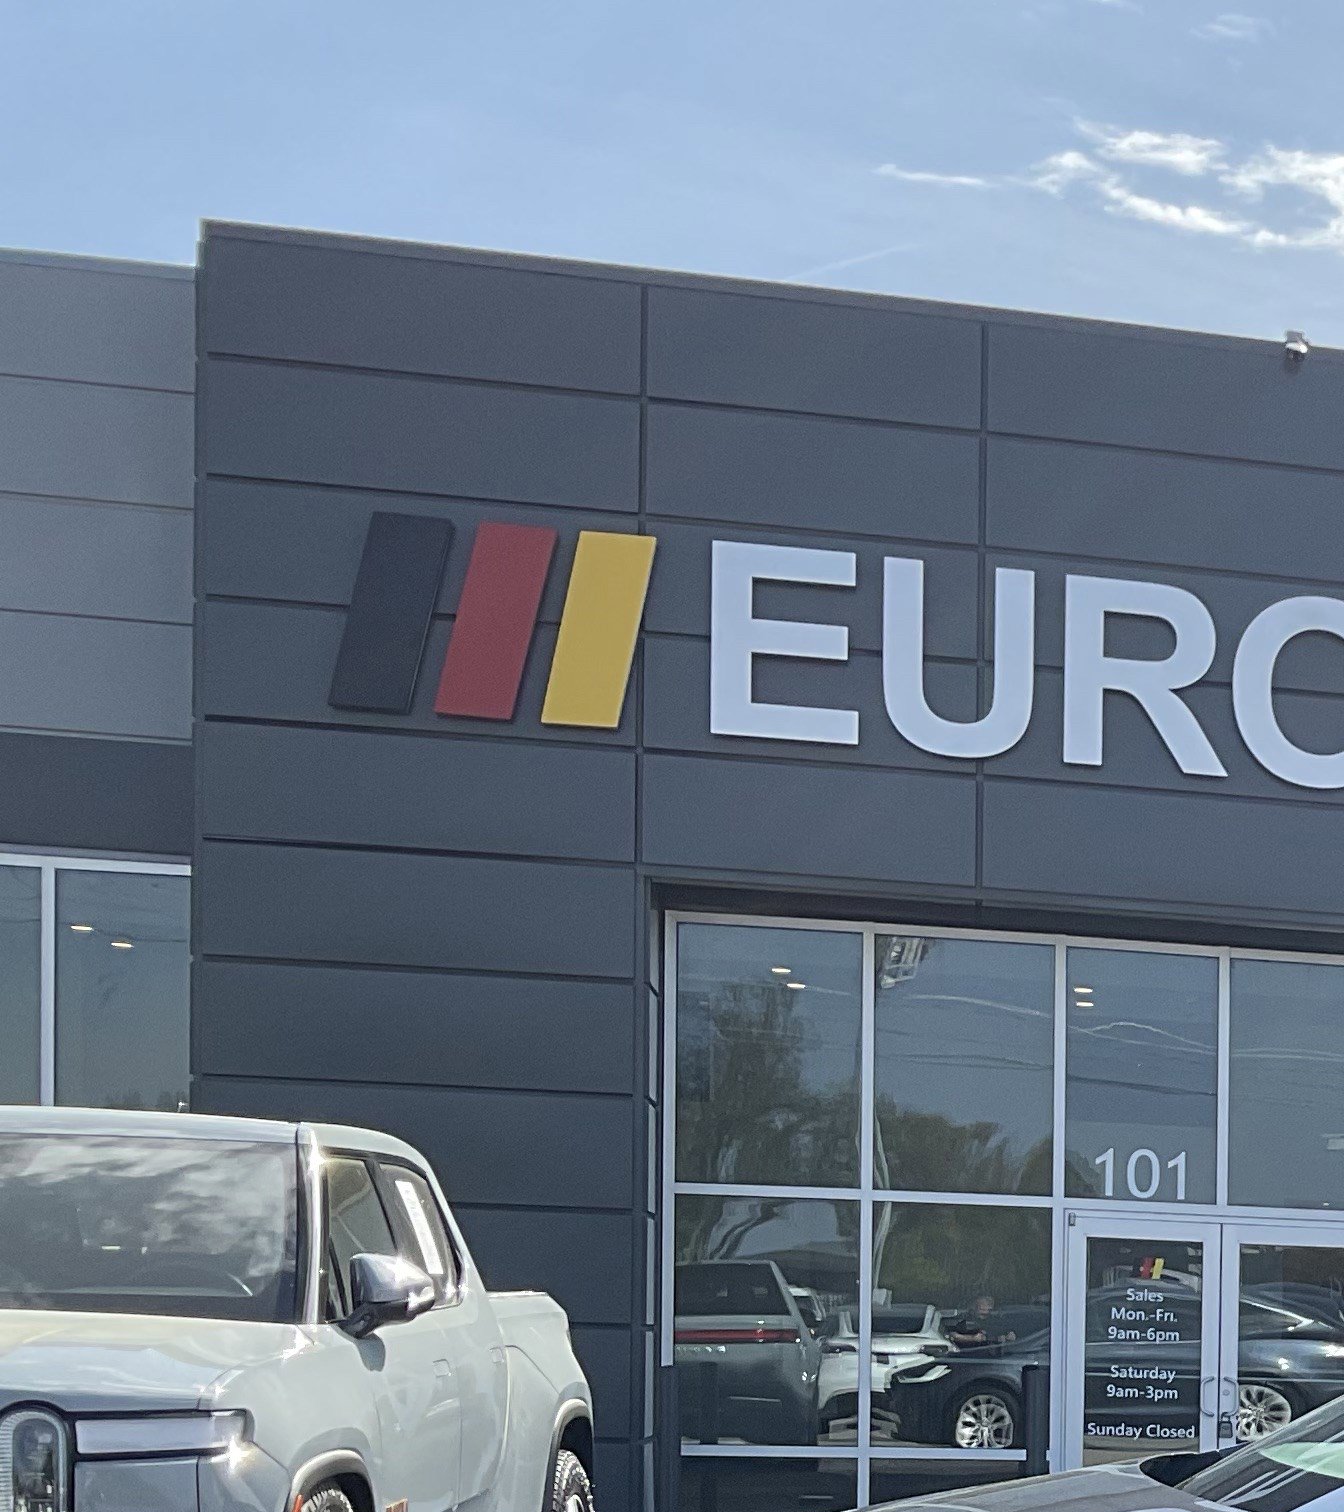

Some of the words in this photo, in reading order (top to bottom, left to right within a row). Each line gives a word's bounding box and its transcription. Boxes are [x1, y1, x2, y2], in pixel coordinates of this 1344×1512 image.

[1095, 1148, 1186, 1200] 101
[1126, 1288, 1164, 1302] Sales
[1111, 1307, 1178, 1323] Mon.-Fri.
[1107, 1326, 1180, 1345] 9am-6pm
[1110, 1364, 1177, 1383] Saturday
[1106, 1384, 1178, 1402] 9am-3pm
[1087, 1422, 1143, 1440] Sunday
[1146, 1424, 1195, 1439] Closed
